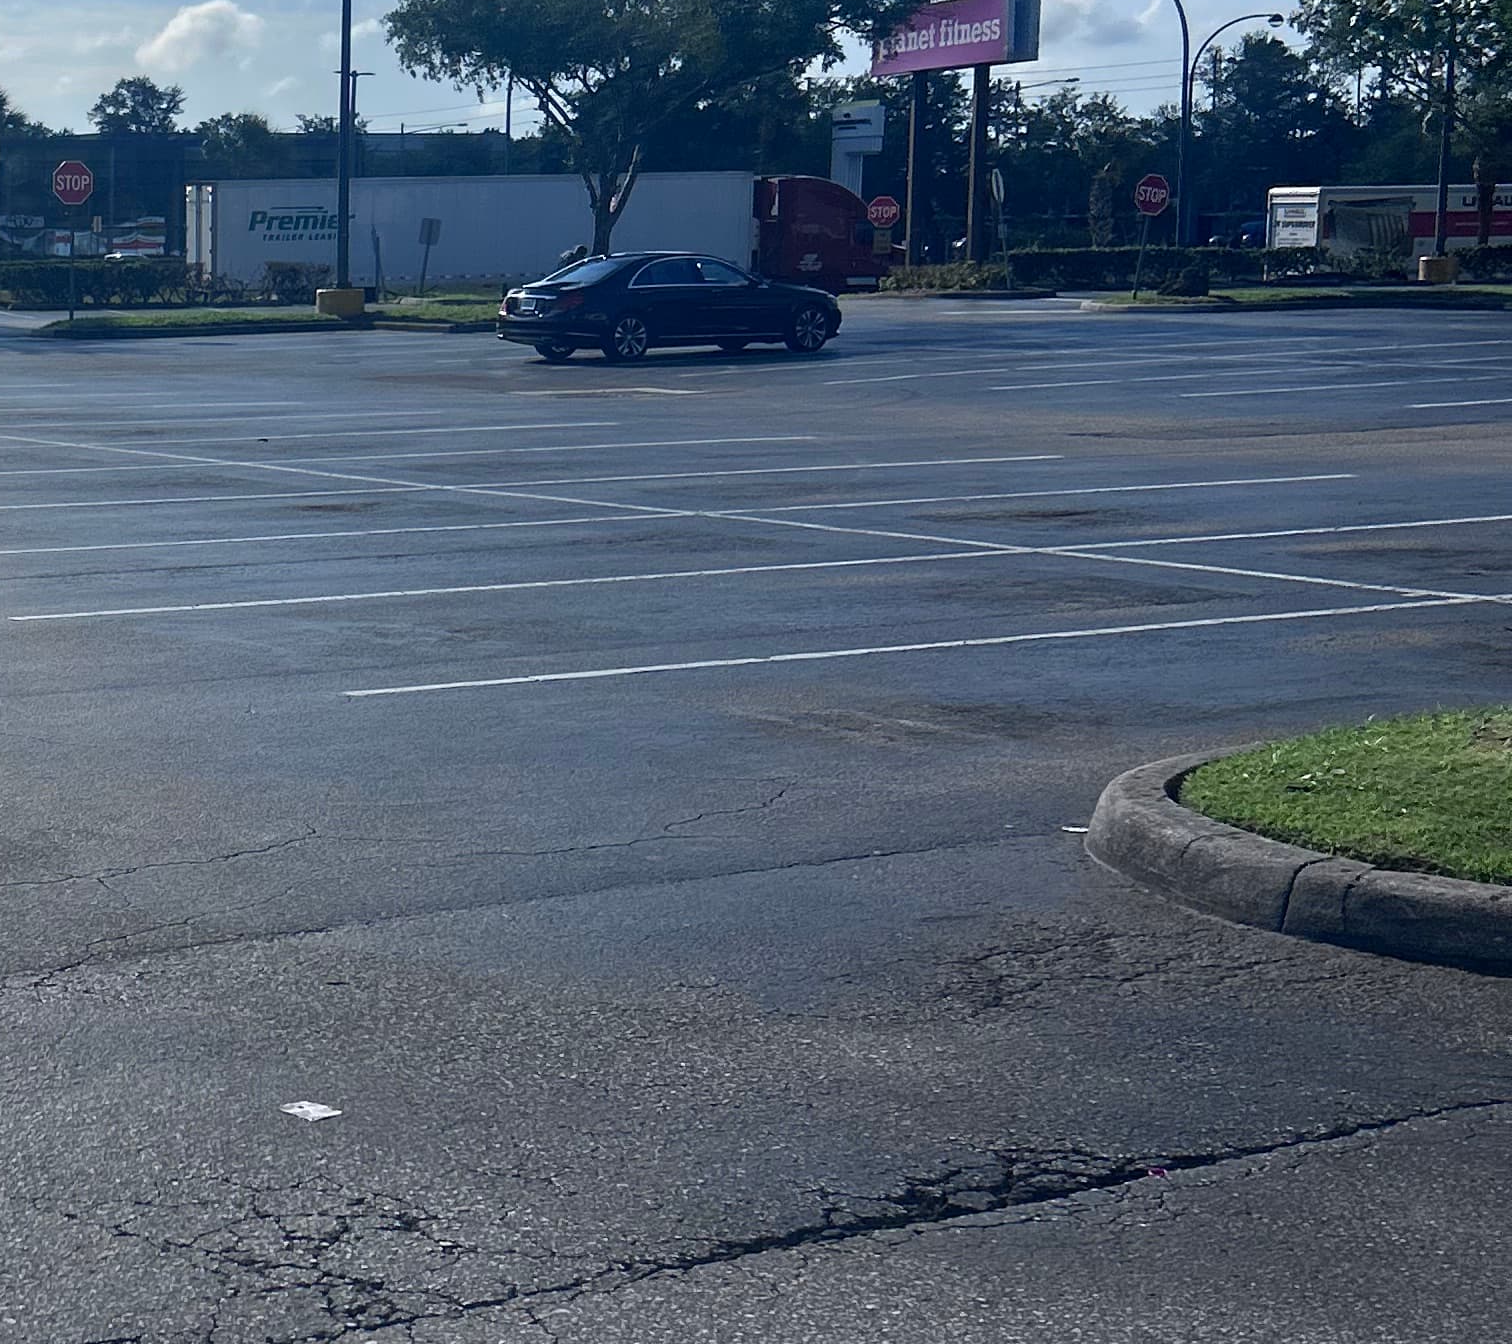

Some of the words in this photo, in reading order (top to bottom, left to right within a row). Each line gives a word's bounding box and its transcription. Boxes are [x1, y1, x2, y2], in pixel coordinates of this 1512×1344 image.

[939, 18, 1001, 48] fitness
[55, 175, 90, 192] STOP
[1137, 185, 1167, 203] STOP
[870, 205, 898, 218] STOP
